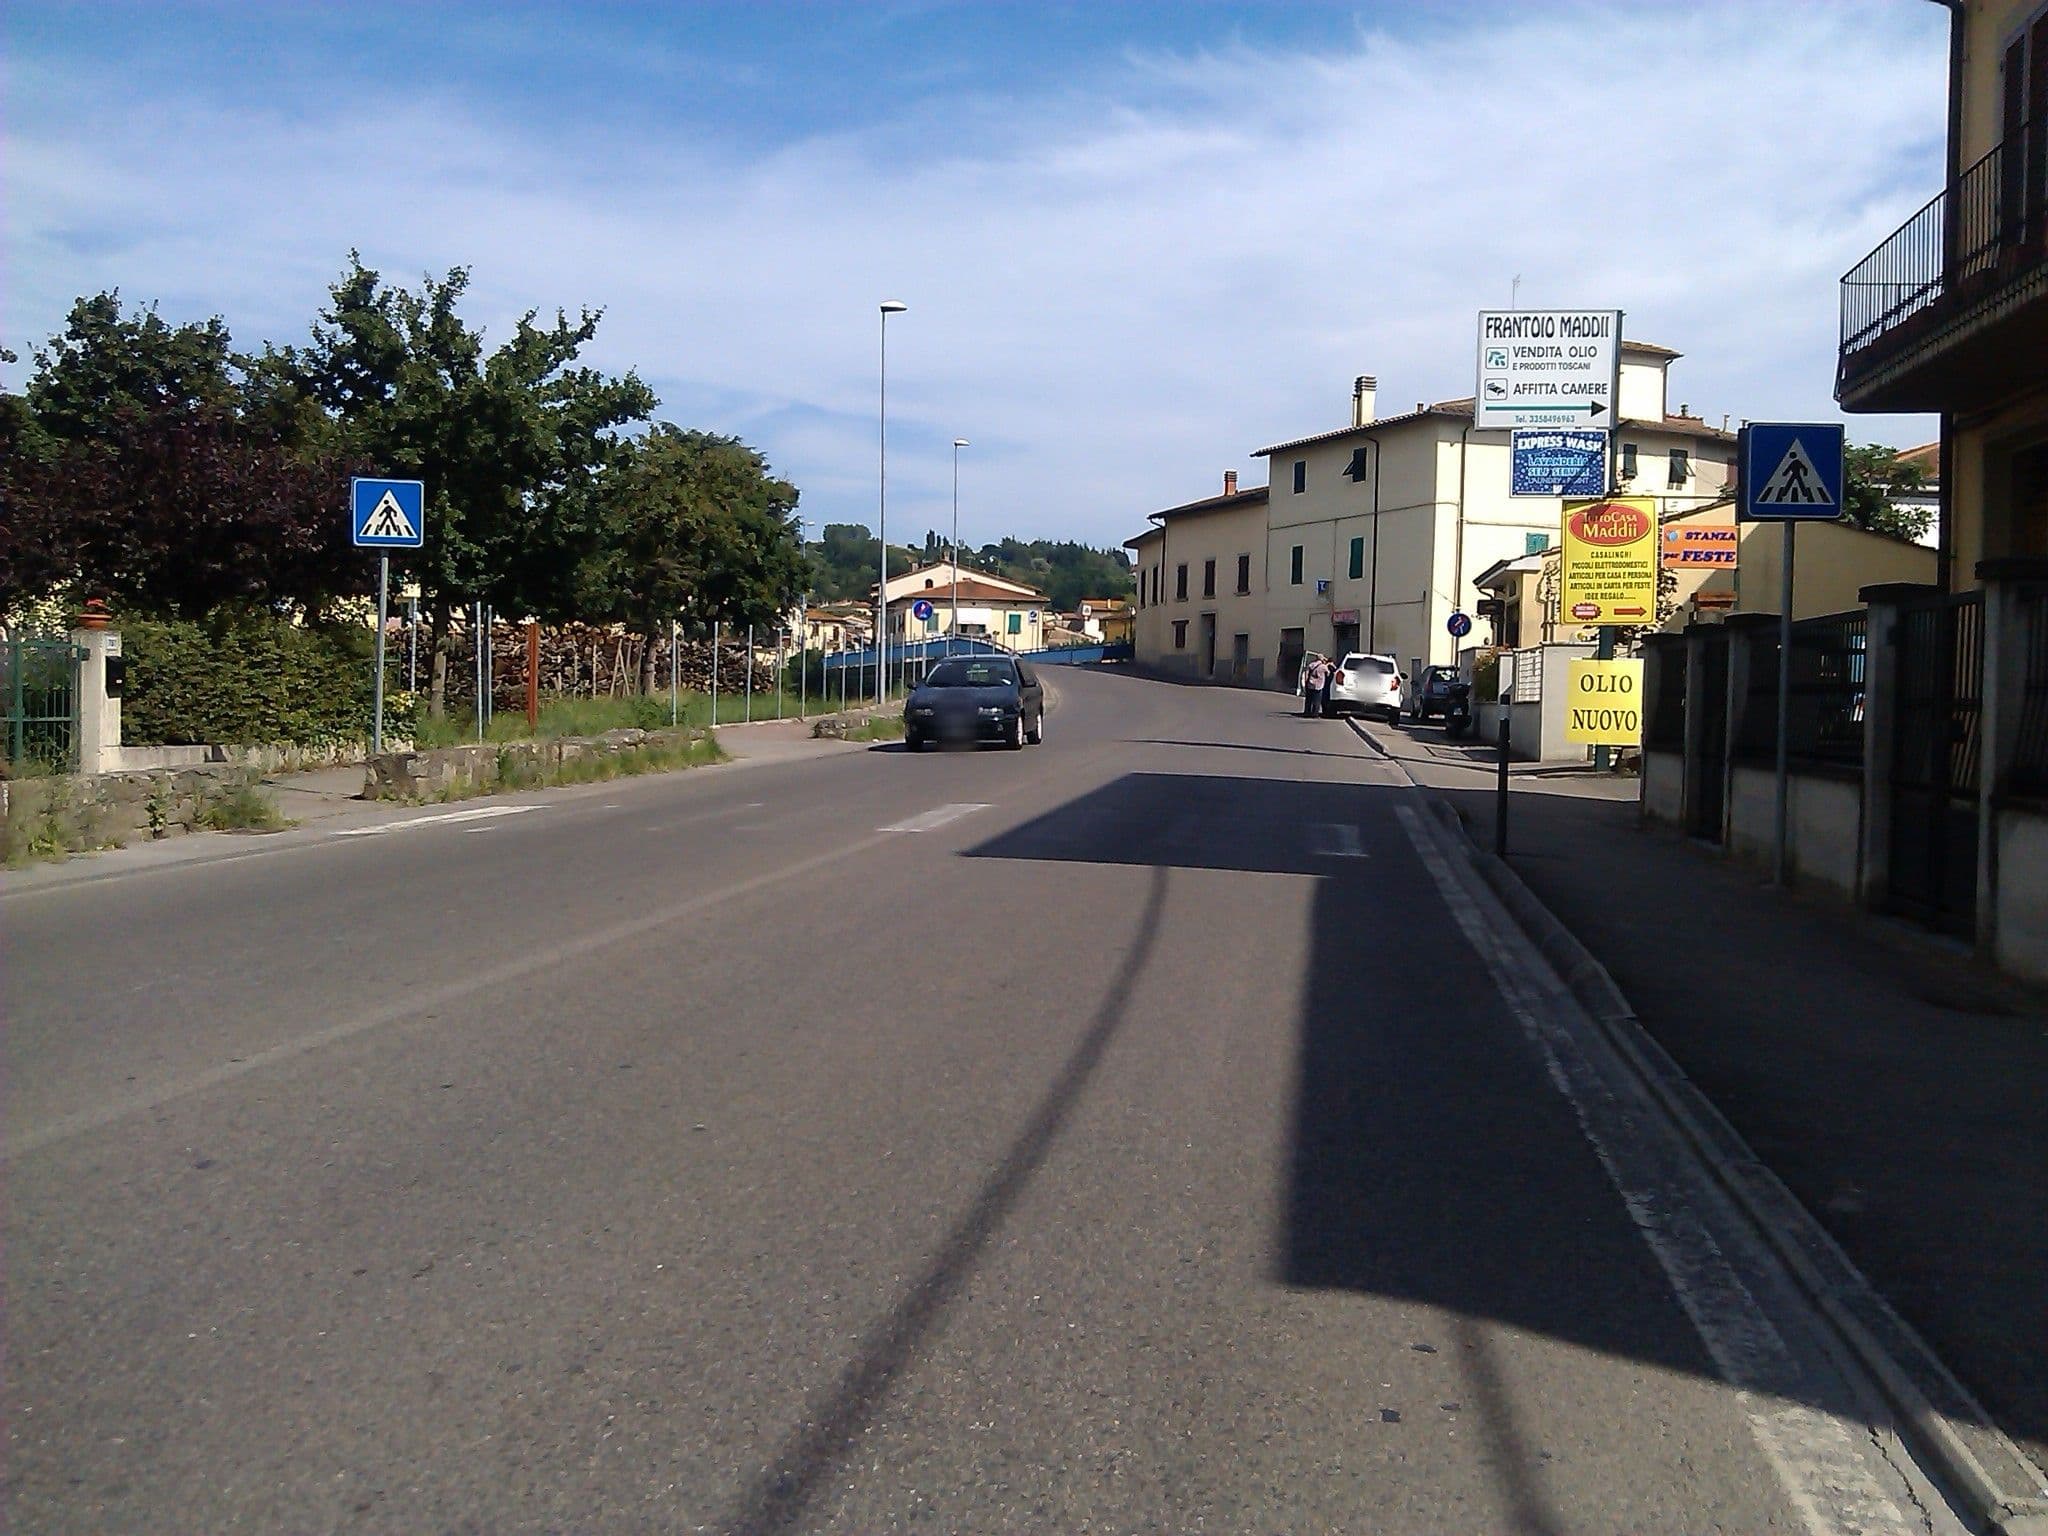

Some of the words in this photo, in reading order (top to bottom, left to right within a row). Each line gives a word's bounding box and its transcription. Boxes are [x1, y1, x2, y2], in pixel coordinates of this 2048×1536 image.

[1486, 316, 1555, 338] FRANTOIO
[1560, 316, 1609, 337] MADDII
[1512, 346, 1563, 358] VENDITA
[1569, 346, 1598, 358] OLIO
[1558, 362, 1591, 370] TOSCANI
[1513, 383, 1557, 395] AFFITTA
[1561, 383, 1608, 395] CAMERE
[1515, 415, 1527, 423] Tel.
[1517, 436, 1563, 450] EXPRESS
[1566, 437, 1602, 452] WASH
[1685, 532, 1736, 540] STANZA
[1591, 551, 1632, 559] CASALINGHI
[1680, 550, 1736, 562] FESTE
[1595, 561, 1648, 569] ELETTRODOMESTICI
[1607, 571, 1621, 579] CASA
[1628, 571, 1652, 579] PERSONA
[1570, 582, 1595, 590] ARTICOLI
[1585, 592, 1599, 600] IDEE
[1580, 674, 1633, 693] OLIO
[1571, 709, 1638, 731] NUOVO
